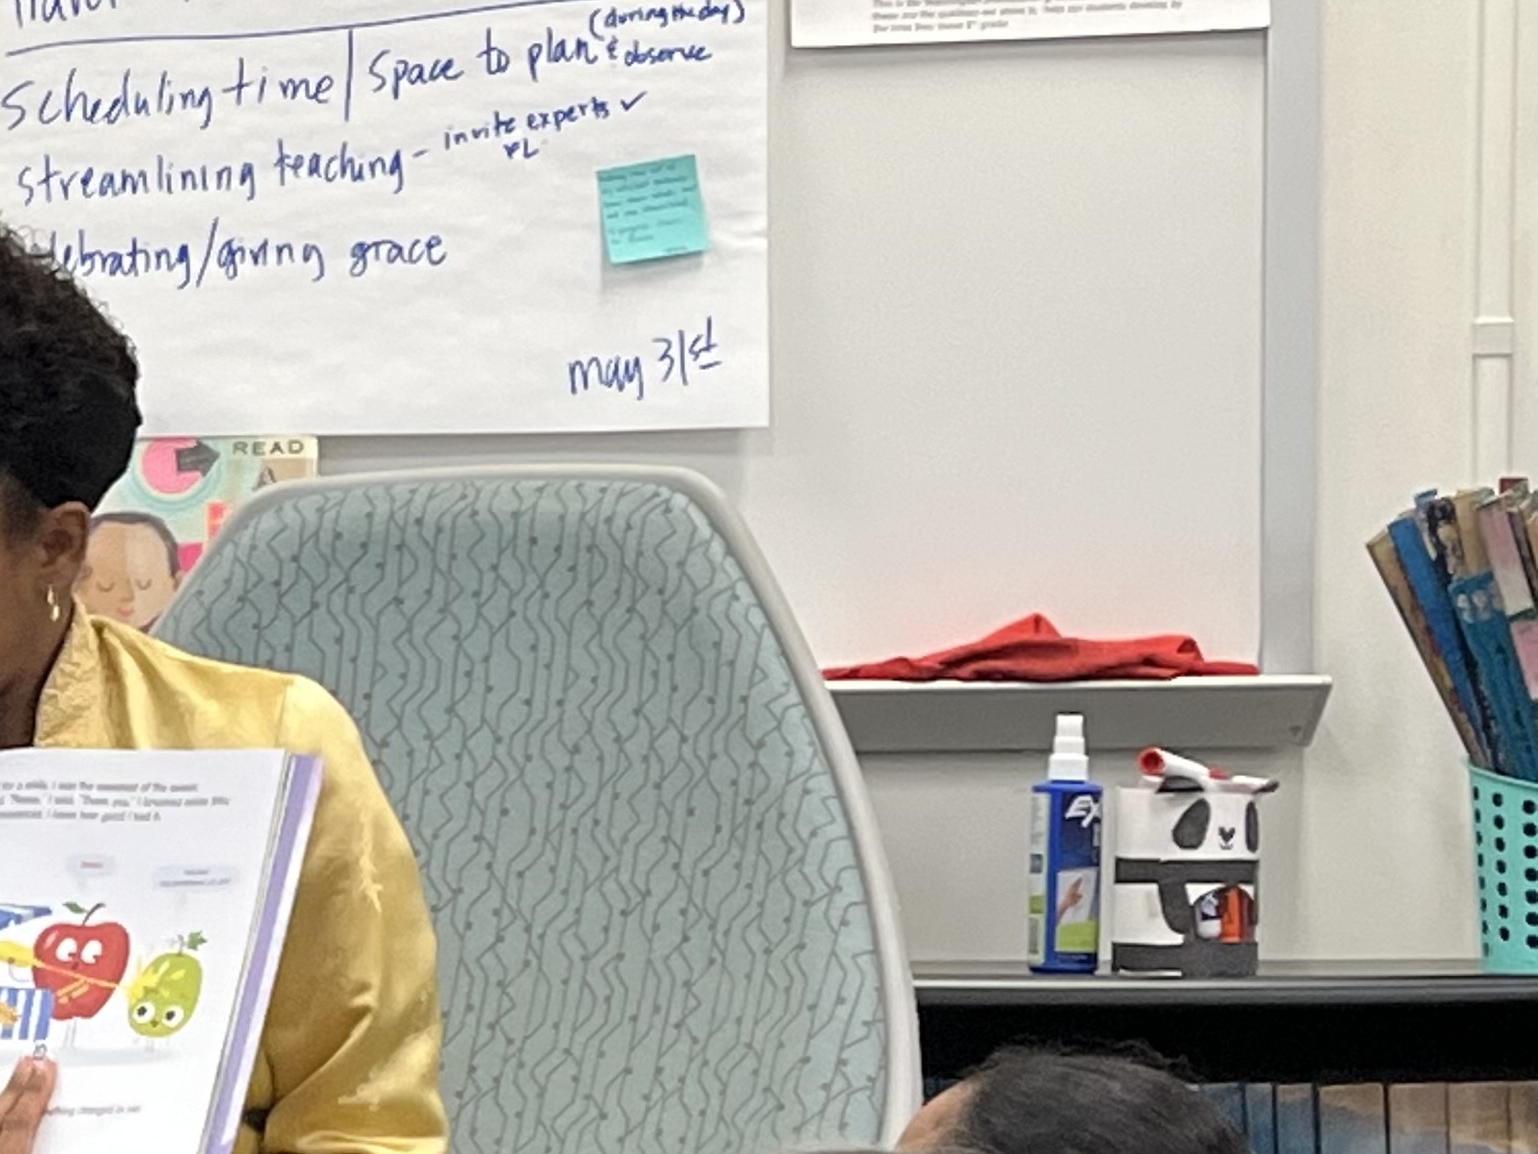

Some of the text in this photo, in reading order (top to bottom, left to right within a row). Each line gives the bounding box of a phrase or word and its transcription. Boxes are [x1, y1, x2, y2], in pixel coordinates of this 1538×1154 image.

[223, 57, 334, 106] time
[476, 27, 510, 75] to
[527, 27, 598, 82] plan
[444, 96, 610, 150] invite experts
[274, 139, 404, 195] teaching
[48, 217, 448, 289] lebrating/giving grace
[232, 439, 304, 456] READ
